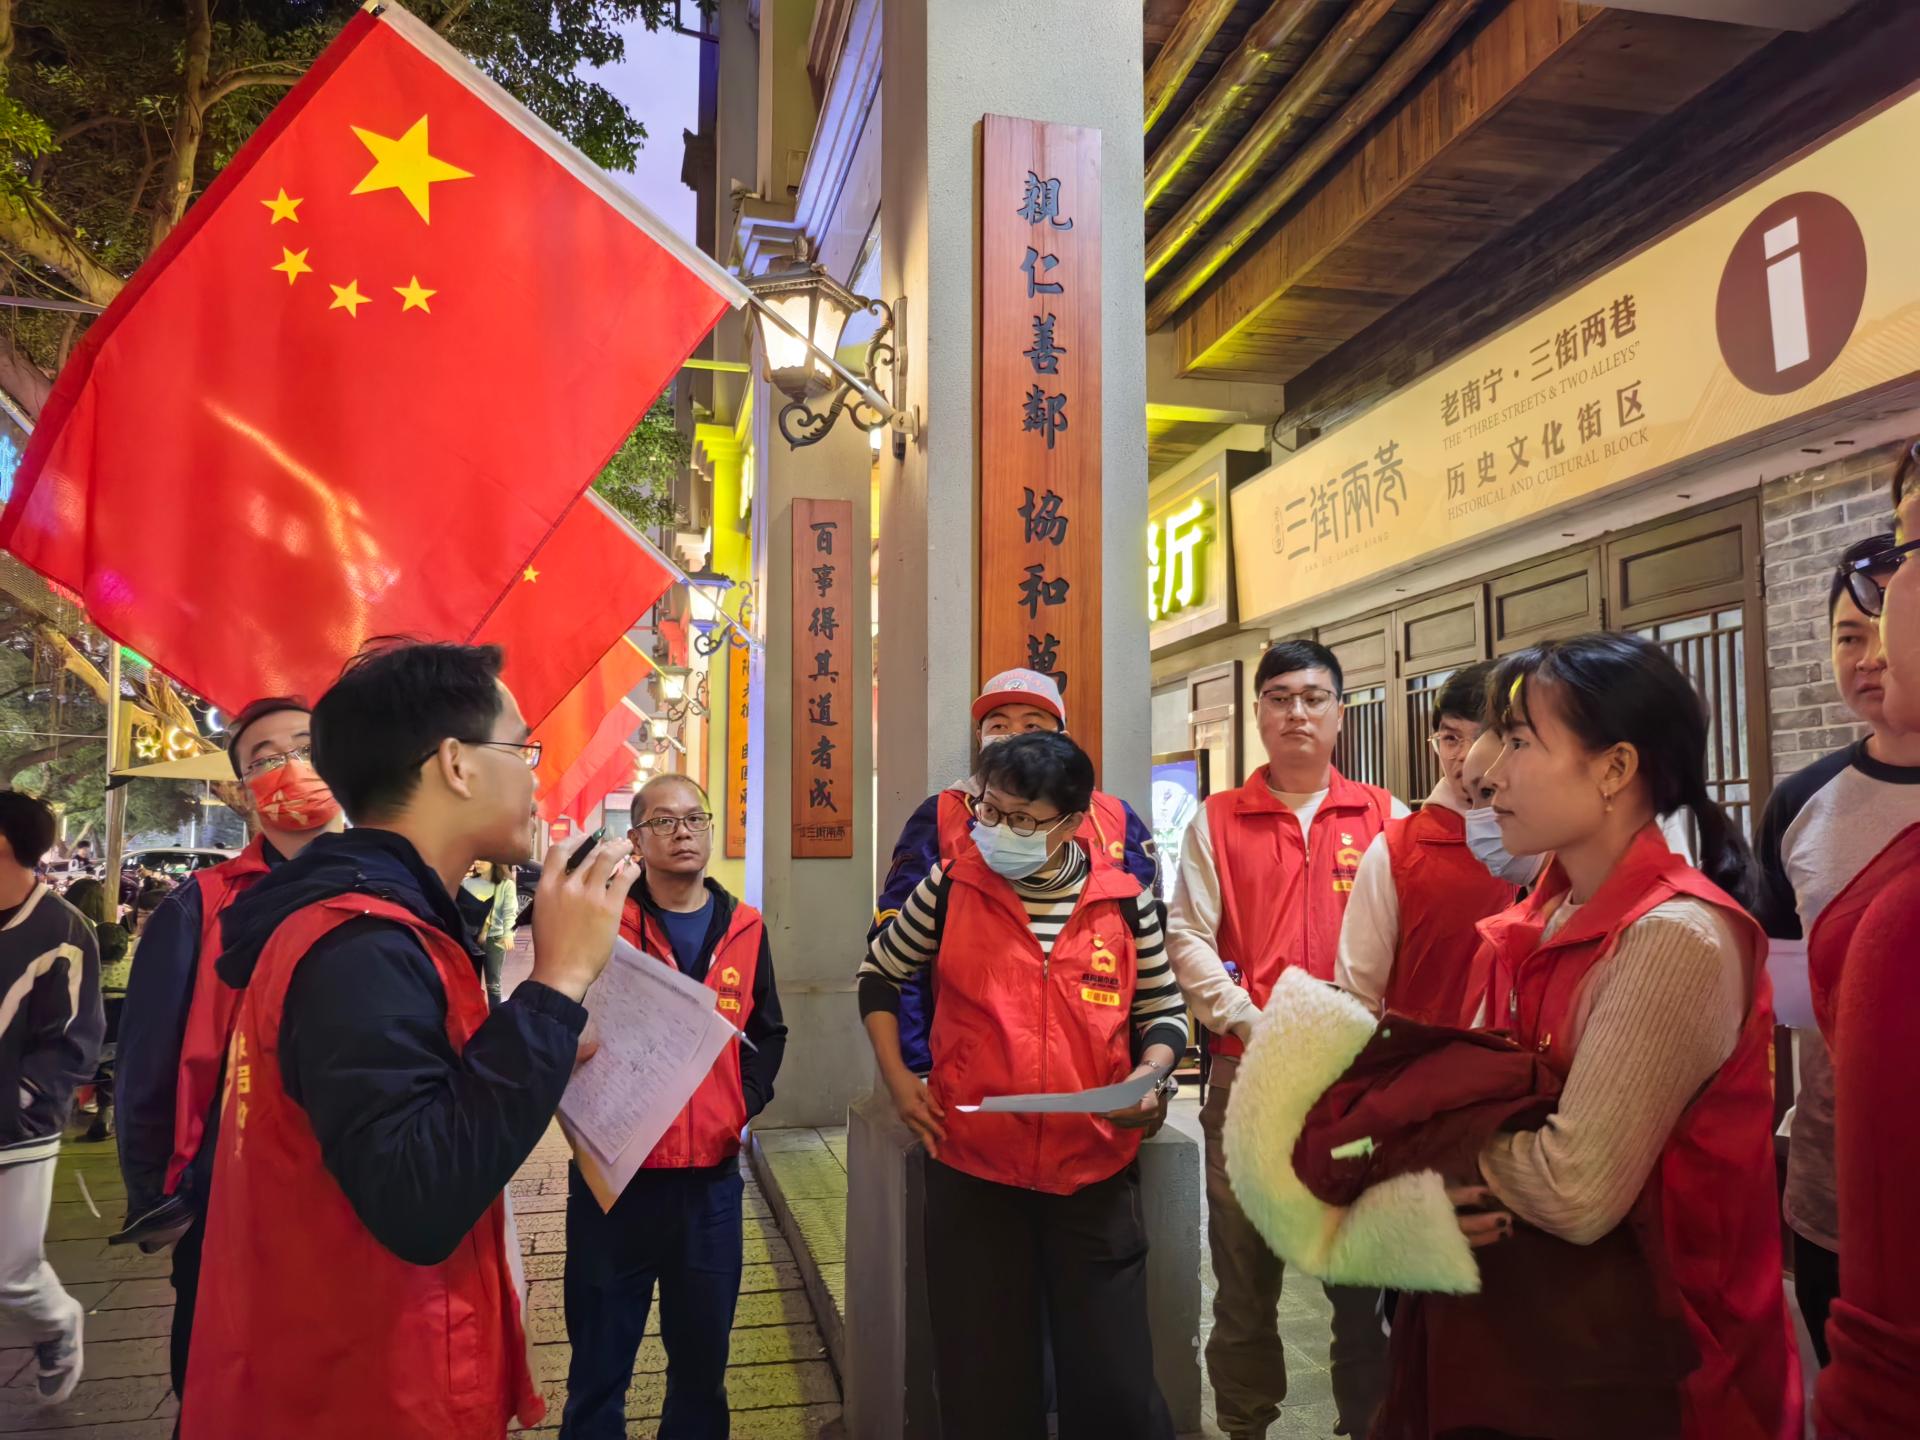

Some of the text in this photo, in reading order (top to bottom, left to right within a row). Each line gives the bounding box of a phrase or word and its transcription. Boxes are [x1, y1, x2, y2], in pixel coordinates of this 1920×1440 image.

[1443, 431, 1462, 450] THE
[1501, 388, 1547, 422] STREETS
[1548, 385, 1557, 400] &
[1559, 368, 1588, 394] TWO
[1446, 379, 1646, 501] 历史文化街区
[1448, 425, 1649, 521] HISTORICAL AND CULTURAL BLOCK
